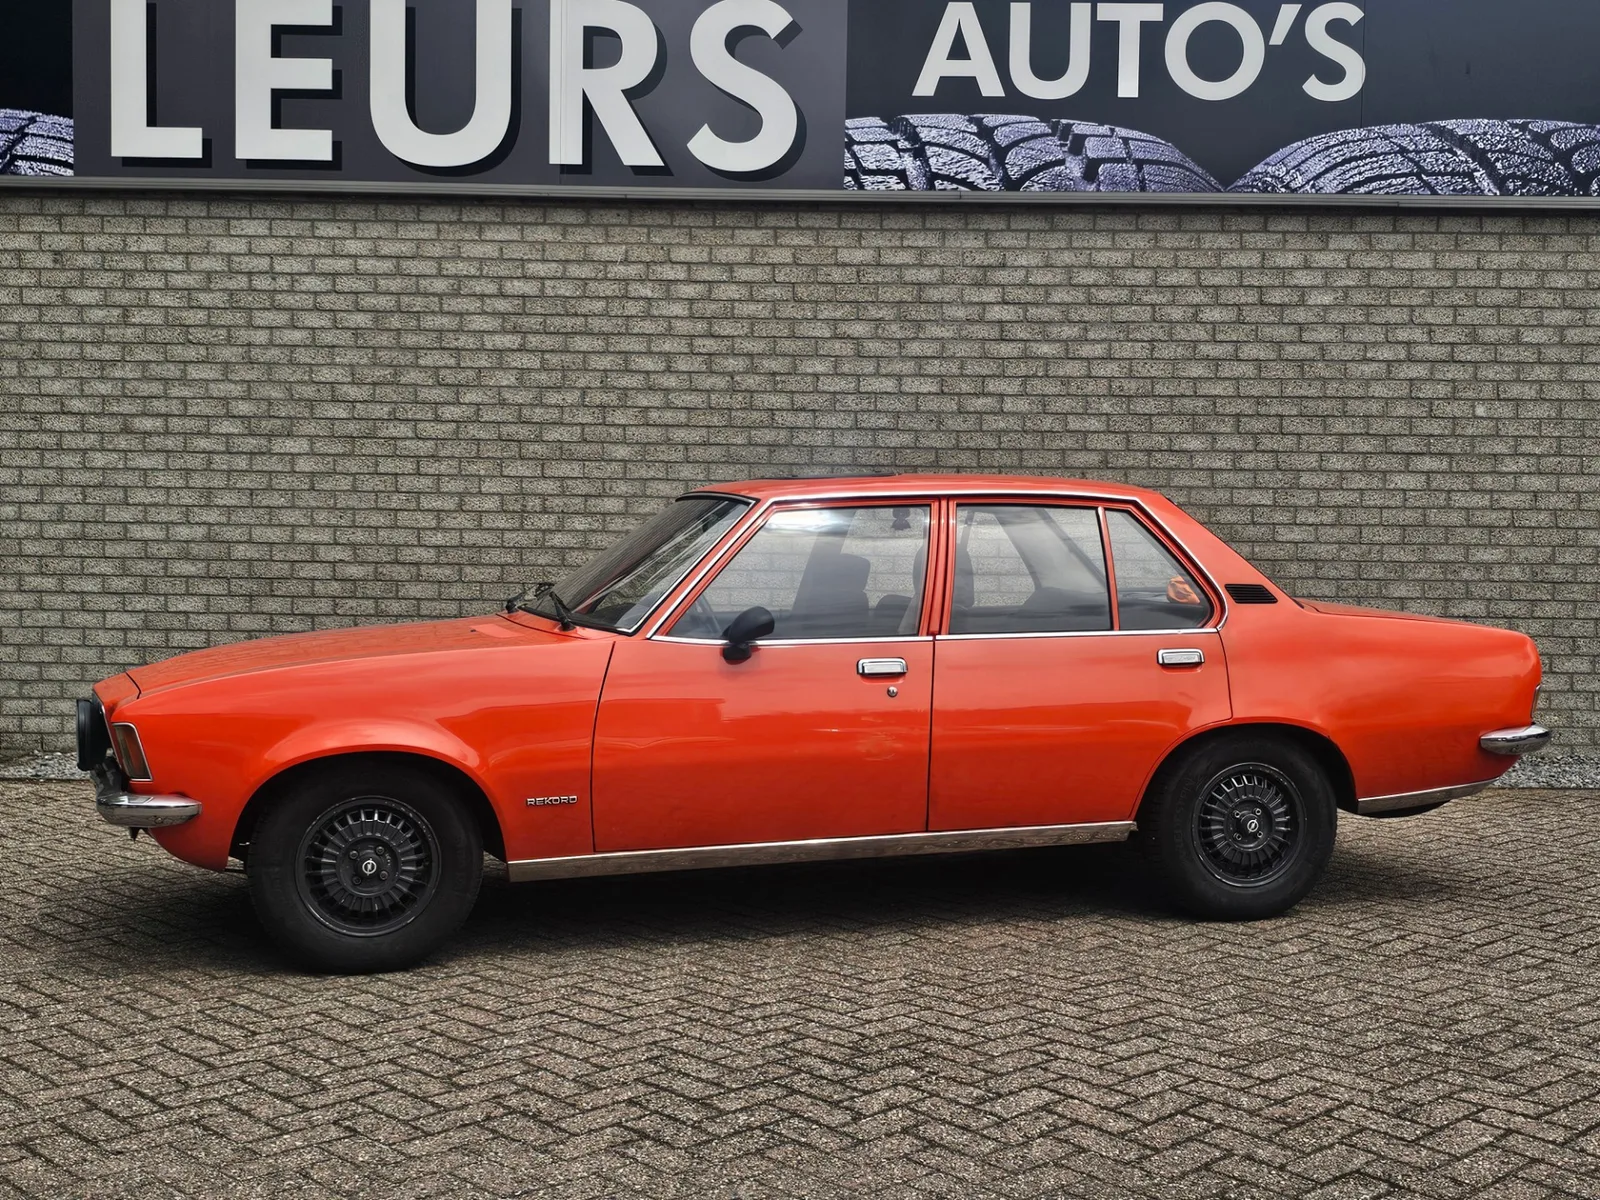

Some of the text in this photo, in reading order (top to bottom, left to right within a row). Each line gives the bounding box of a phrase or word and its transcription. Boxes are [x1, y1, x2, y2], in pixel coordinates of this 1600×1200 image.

[110, 0, 1366, 172] LEURS AUTO'S
[526, 795, 578, 806] REKORD
